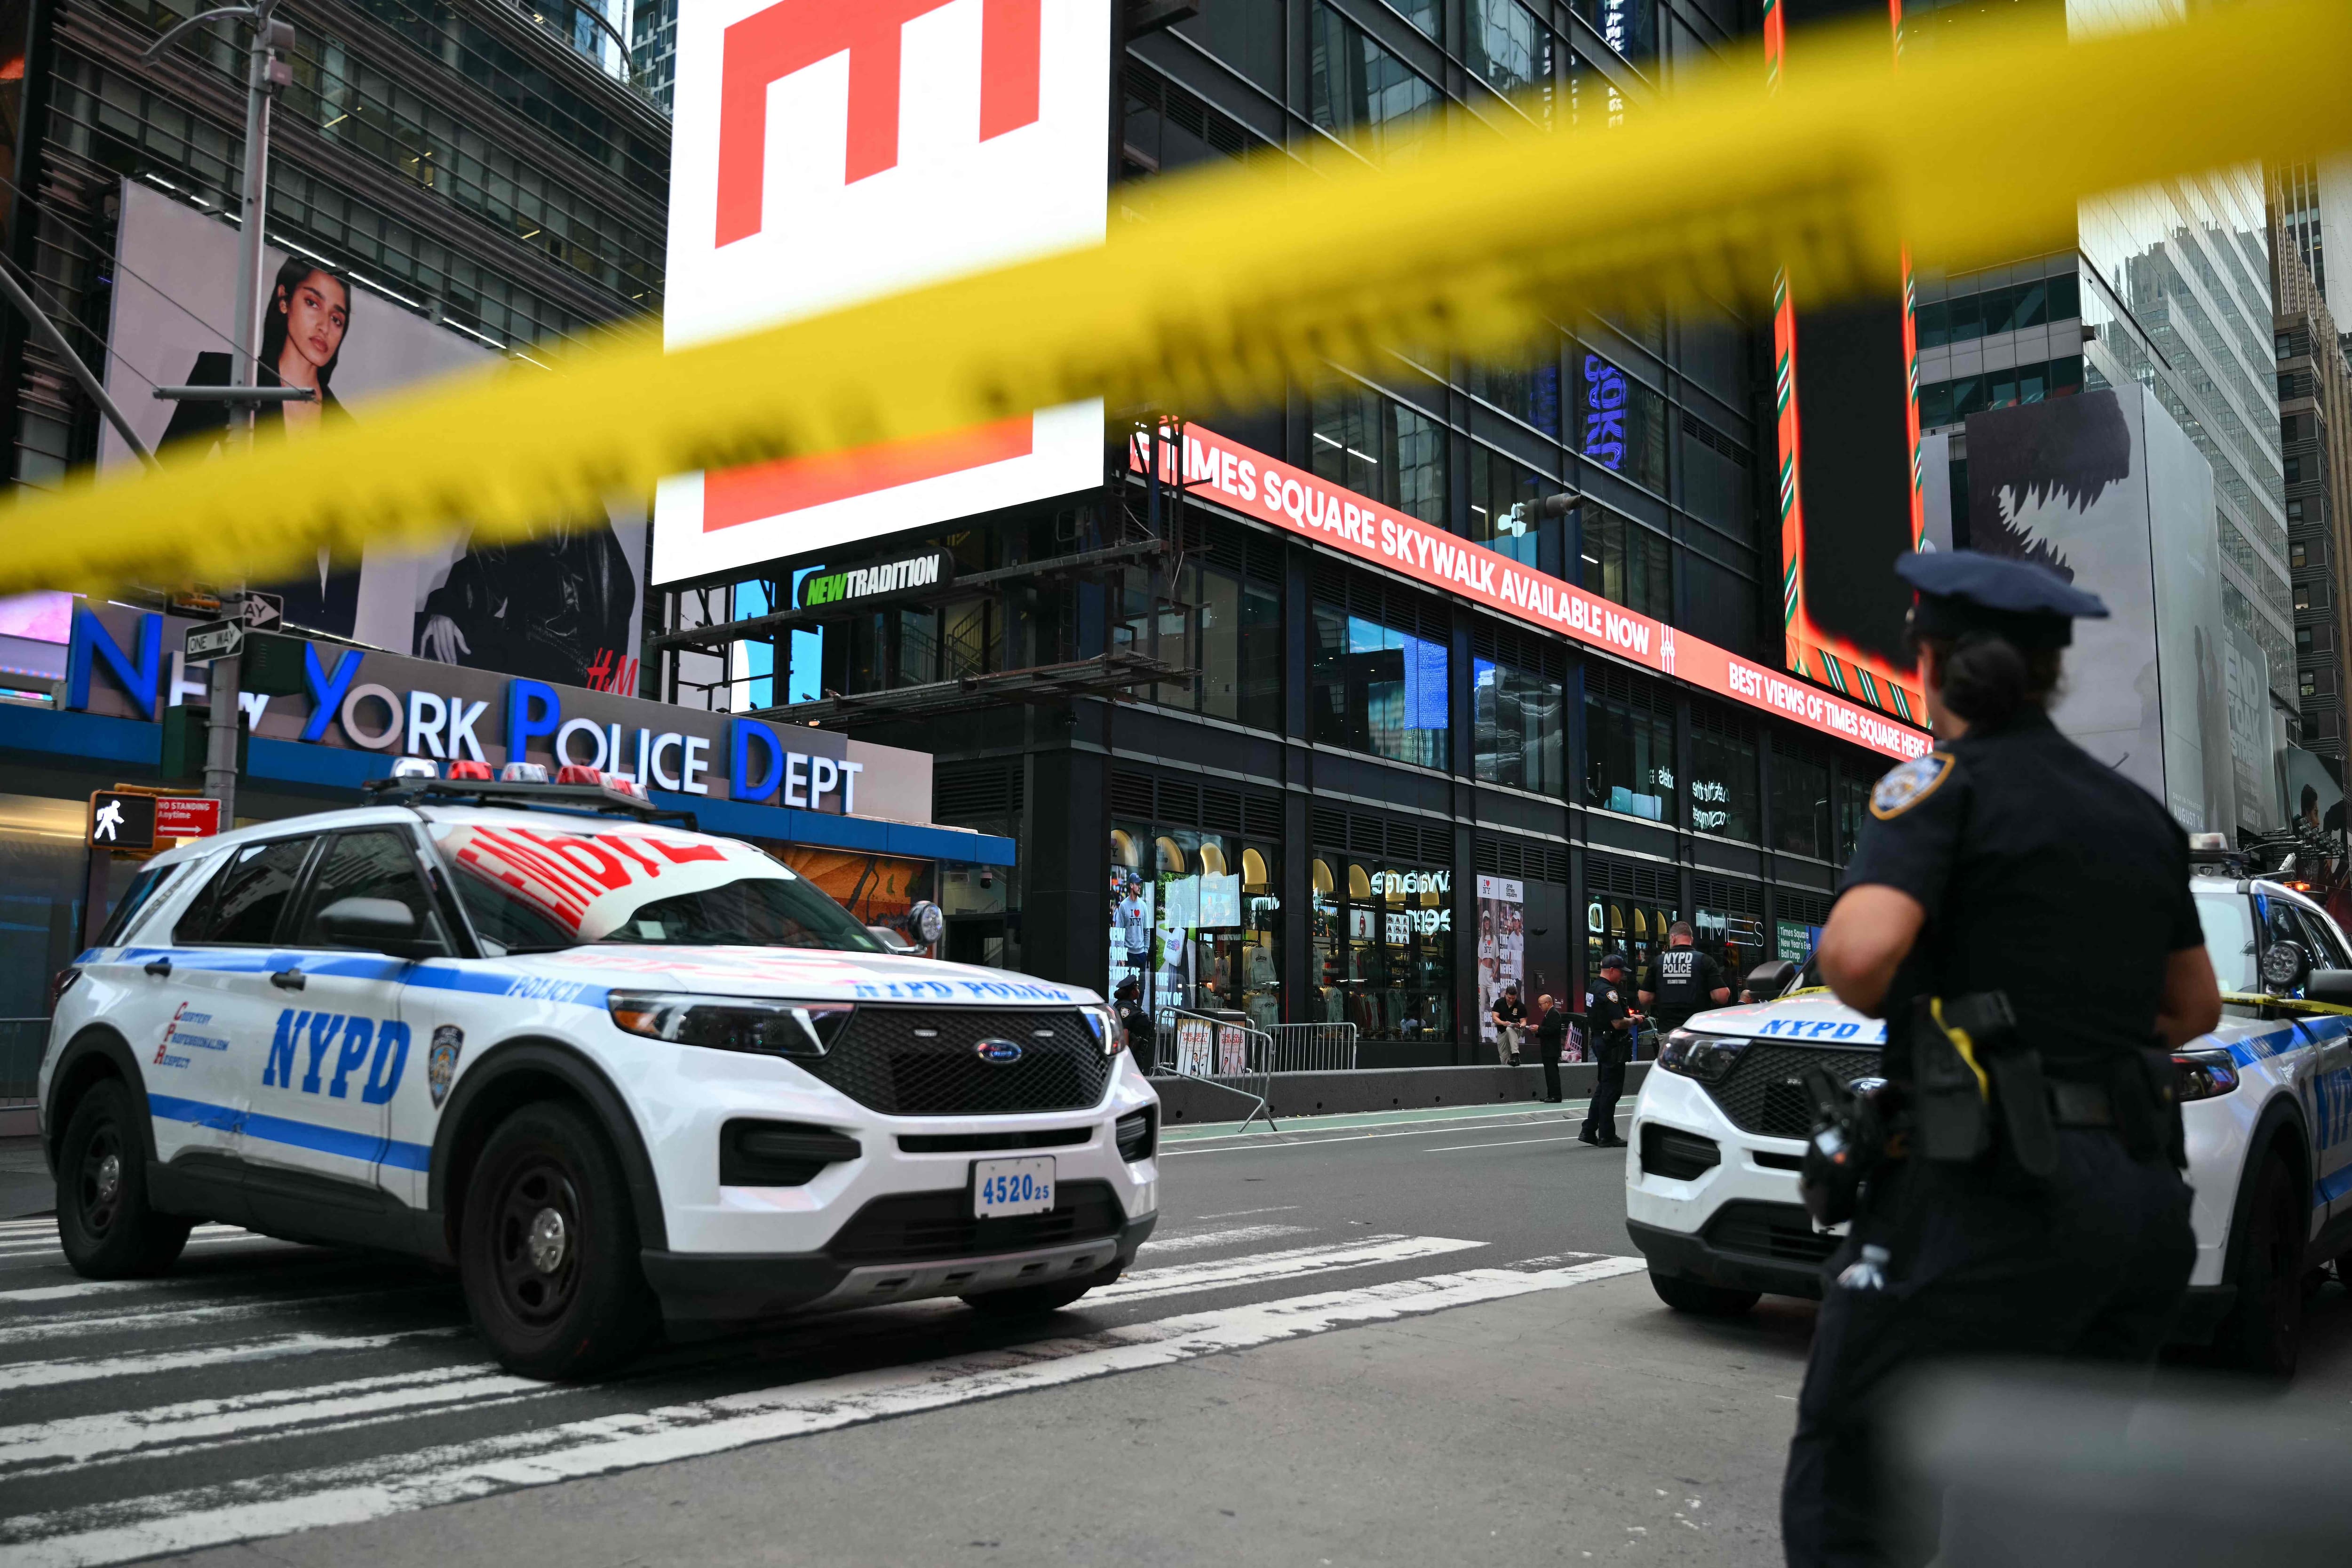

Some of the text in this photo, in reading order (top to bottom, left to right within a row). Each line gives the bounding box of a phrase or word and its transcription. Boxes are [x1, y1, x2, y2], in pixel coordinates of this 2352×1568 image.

[1160, 426, 1256, 501] TIMES
[1264, 470, 1375, 548] SQUARE
[1381, 519, 1496, 596] SKYWALK
[1499, 568, 1600, 637] AVAILABLE
[1605, 613, 1649, 655] NOW
[244, 603, 266, 618] AY
[190, 630, 234, 652] ONE WAY
[586, 647, 638, 697] H&M
[2225, 641, 2259, 711] END
[1729, 662, 1924, 759] BEST VIEWS OF TIMES SQUARE HERE
[299, 641, 489, 762] YORK
[505, 678, 710, 795] POLICE
[729, 717, 864, 815] DEPT
[158, 810, 191, 820] Anytime
[171, 802, 210, 811] STANDING
[2243, 804, 2256, 826] AUGUST
[2174, 804, 2203, 831] AUGUST 14
[1500, 933, 1509, 945] THE
[1780, 926, 1809, 940] Times Square
[1780, 938, 1790, 947] New
[1791, 939, 1804, 949] Year's
[1663, 952, 1692, 963] NYPD
[1790, 950, 1800, 962] Drop
[1500, 963, 1514, 975] NEVER
[1663, 963, 1691, 973] POLICE
[1155, 972, 1168, 986] THE
[505, 976, 587, 1003] POLICE
[854, 980, 1072, 1002] NYPD POLICE
[1155, 991, 1183, 1006] CITY OF
[1484, 1011, 1493, 1022] BIG
[1759, 1019, 1860, 1039] NYPD
[262, 1008, 412, 1105] NYPD
[984, 1174, 1049, 1205] 4520 25
